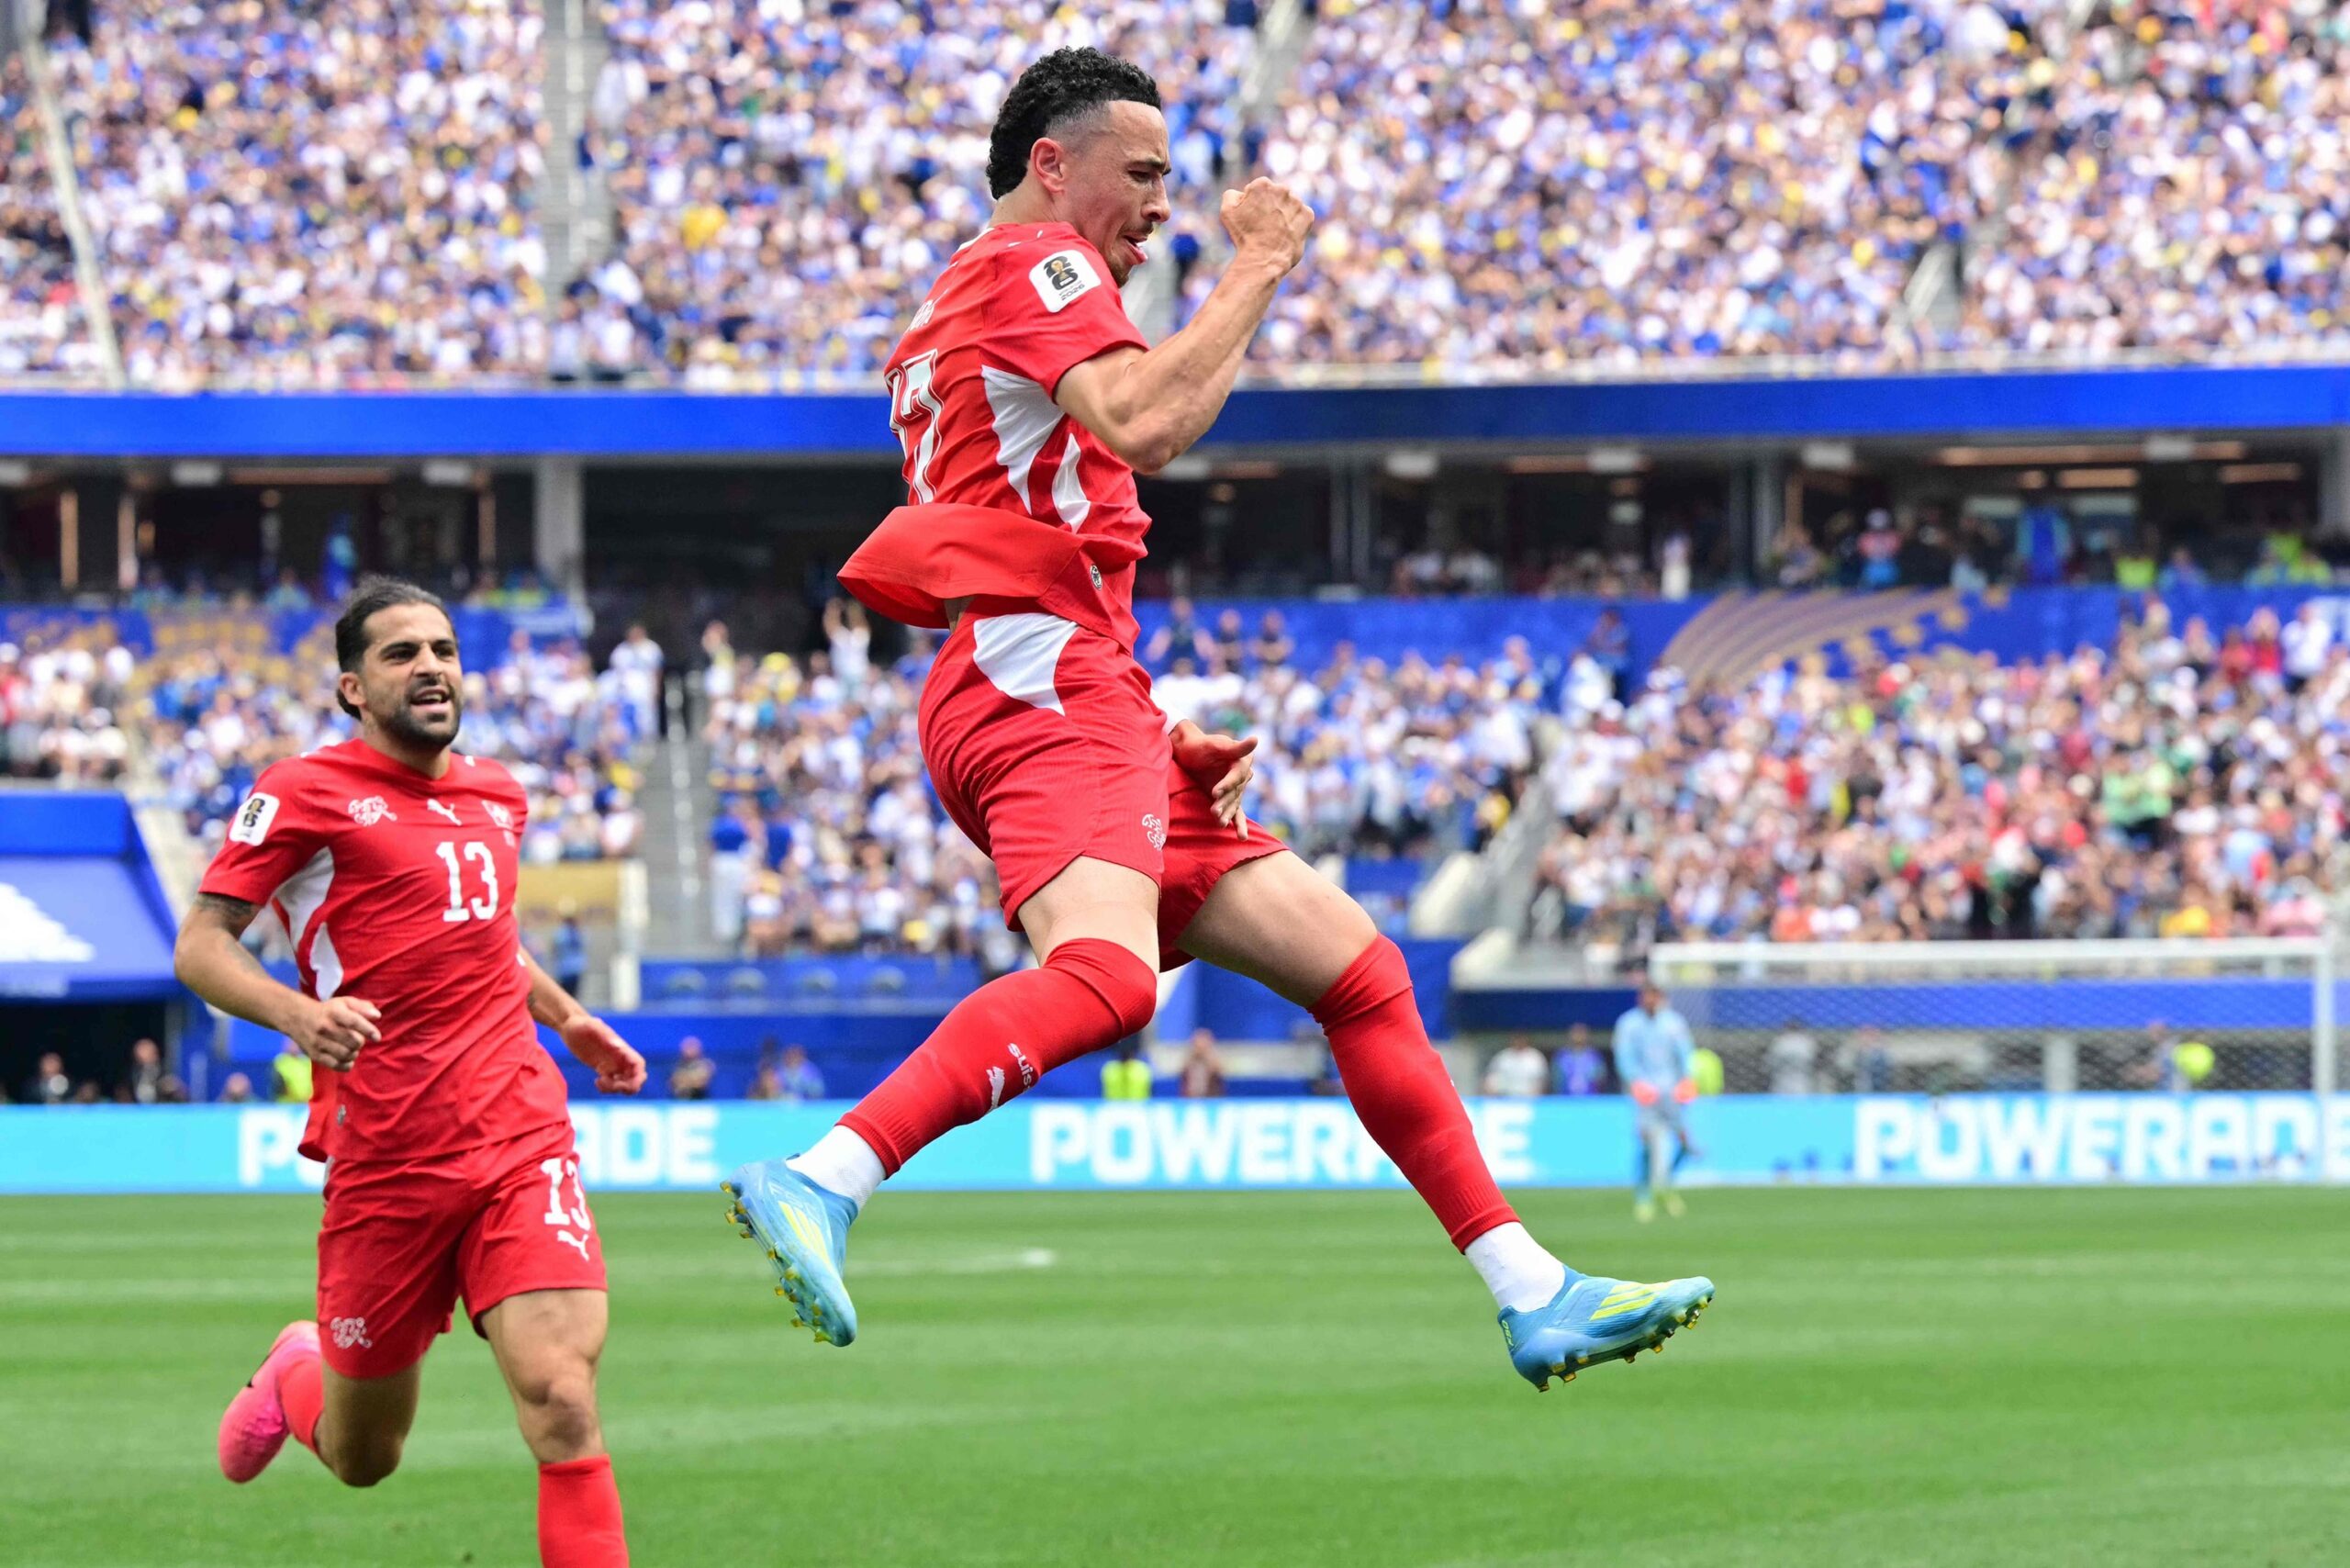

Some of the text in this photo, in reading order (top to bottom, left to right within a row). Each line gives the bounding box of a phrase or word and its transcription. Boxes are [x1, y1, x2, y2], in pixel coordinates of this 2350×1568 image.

[436, 841, 499, 922] 13
[1032, 1103, 1534, 1183] POWERE
[541, 1158, 591, 1230] 13
